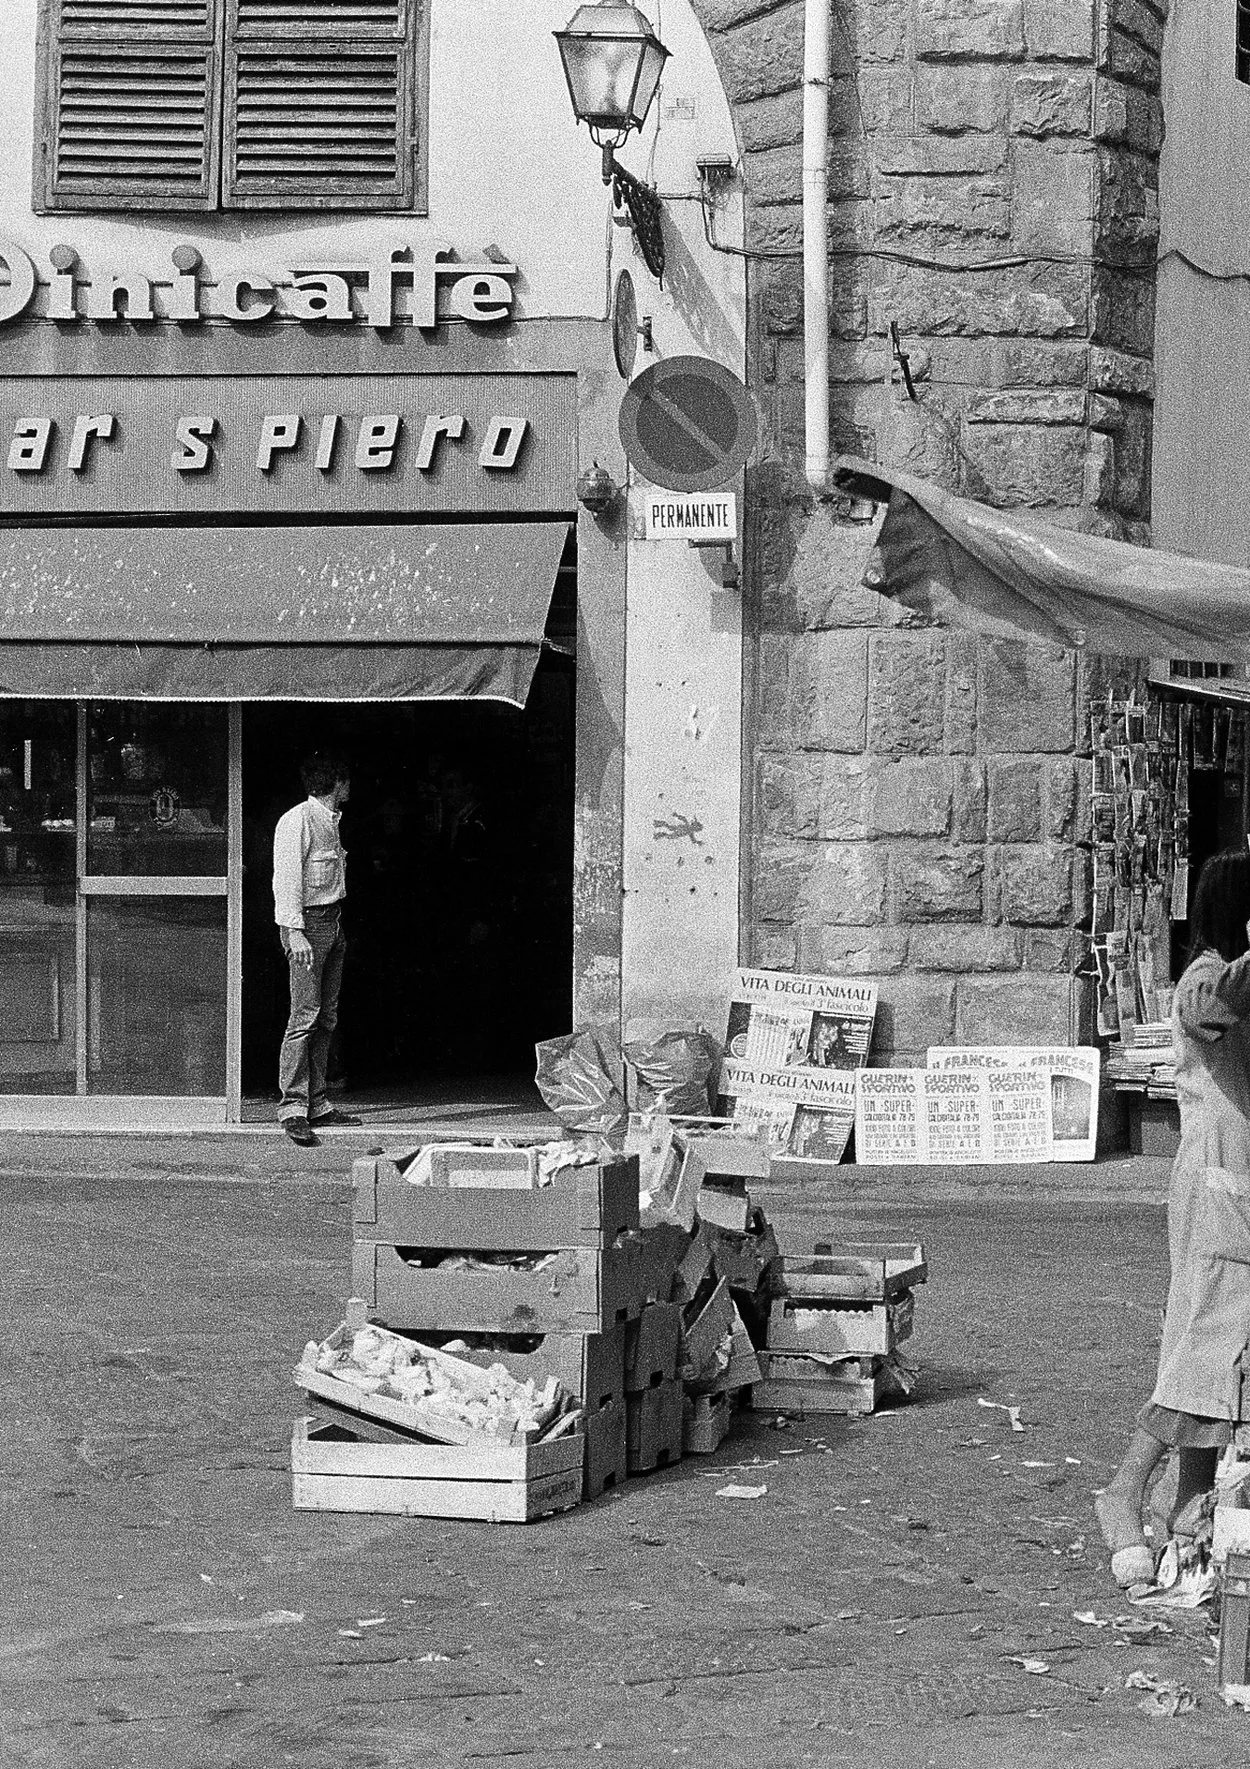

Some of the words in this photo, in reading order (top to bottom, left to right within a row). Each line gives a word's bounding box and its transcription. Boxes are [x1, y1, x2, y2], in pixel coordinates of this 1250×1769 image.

[7, 414, 113, 469] ar
[170, 416, 214, 470] s
[652, 504, 728, 528] PERMANENTE
[741, 976, 770, 990] VITA
[774, 979, 813, 996] DEGLI
[815, 984, 872, 1001] ANIMALI
[727, 1069, 755, 1084] VITA
[760, 1073, 798, 1089] DEGLI
[800, 1078, 856, 1095] ANIMALI
[861, 1073, 908, 1084] GUERIN
[924, 1073, 972, 1085] GUERIN
[988, 1072, 1038, 1084] GUERIN
[863, 1099, 876, 1112] UN
[927, 1100, 939, 1113] UN
